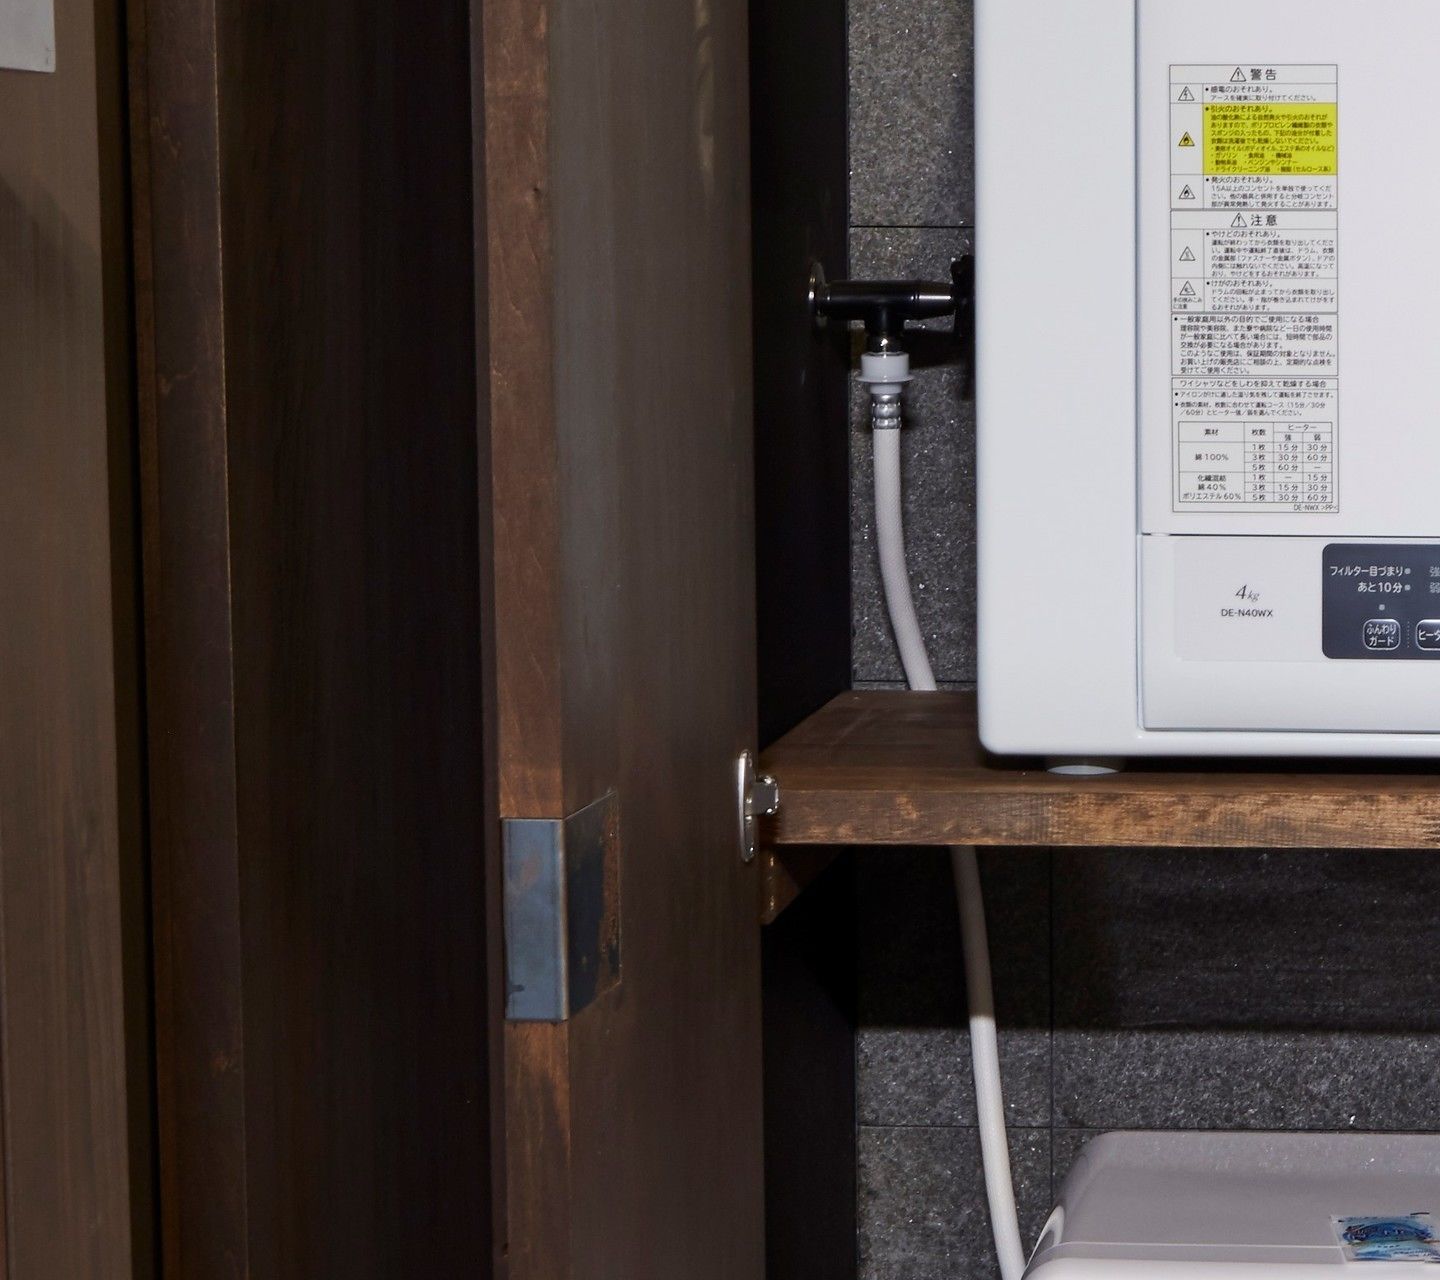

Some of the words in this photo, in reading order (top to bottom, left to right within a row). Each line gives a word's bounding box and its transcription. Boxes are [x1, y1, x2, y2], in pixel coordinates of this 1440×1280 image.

[1250, 69, 1277, 81] 警告
[1251, 214, 1277, 226] 注意
[1330, 566, 1403, 577] フィルター目づまり
[1429, 566, 1440, 577] 強
[1358, 582, 1403, 594] あと10分
[1429, 582, 1440, 594] 弱
[1221, 609, 1274, 618] DE-N40WX
[1366, 624, 1396, 635] ふんわり
[1369, 636, 1394, 647] ガード
